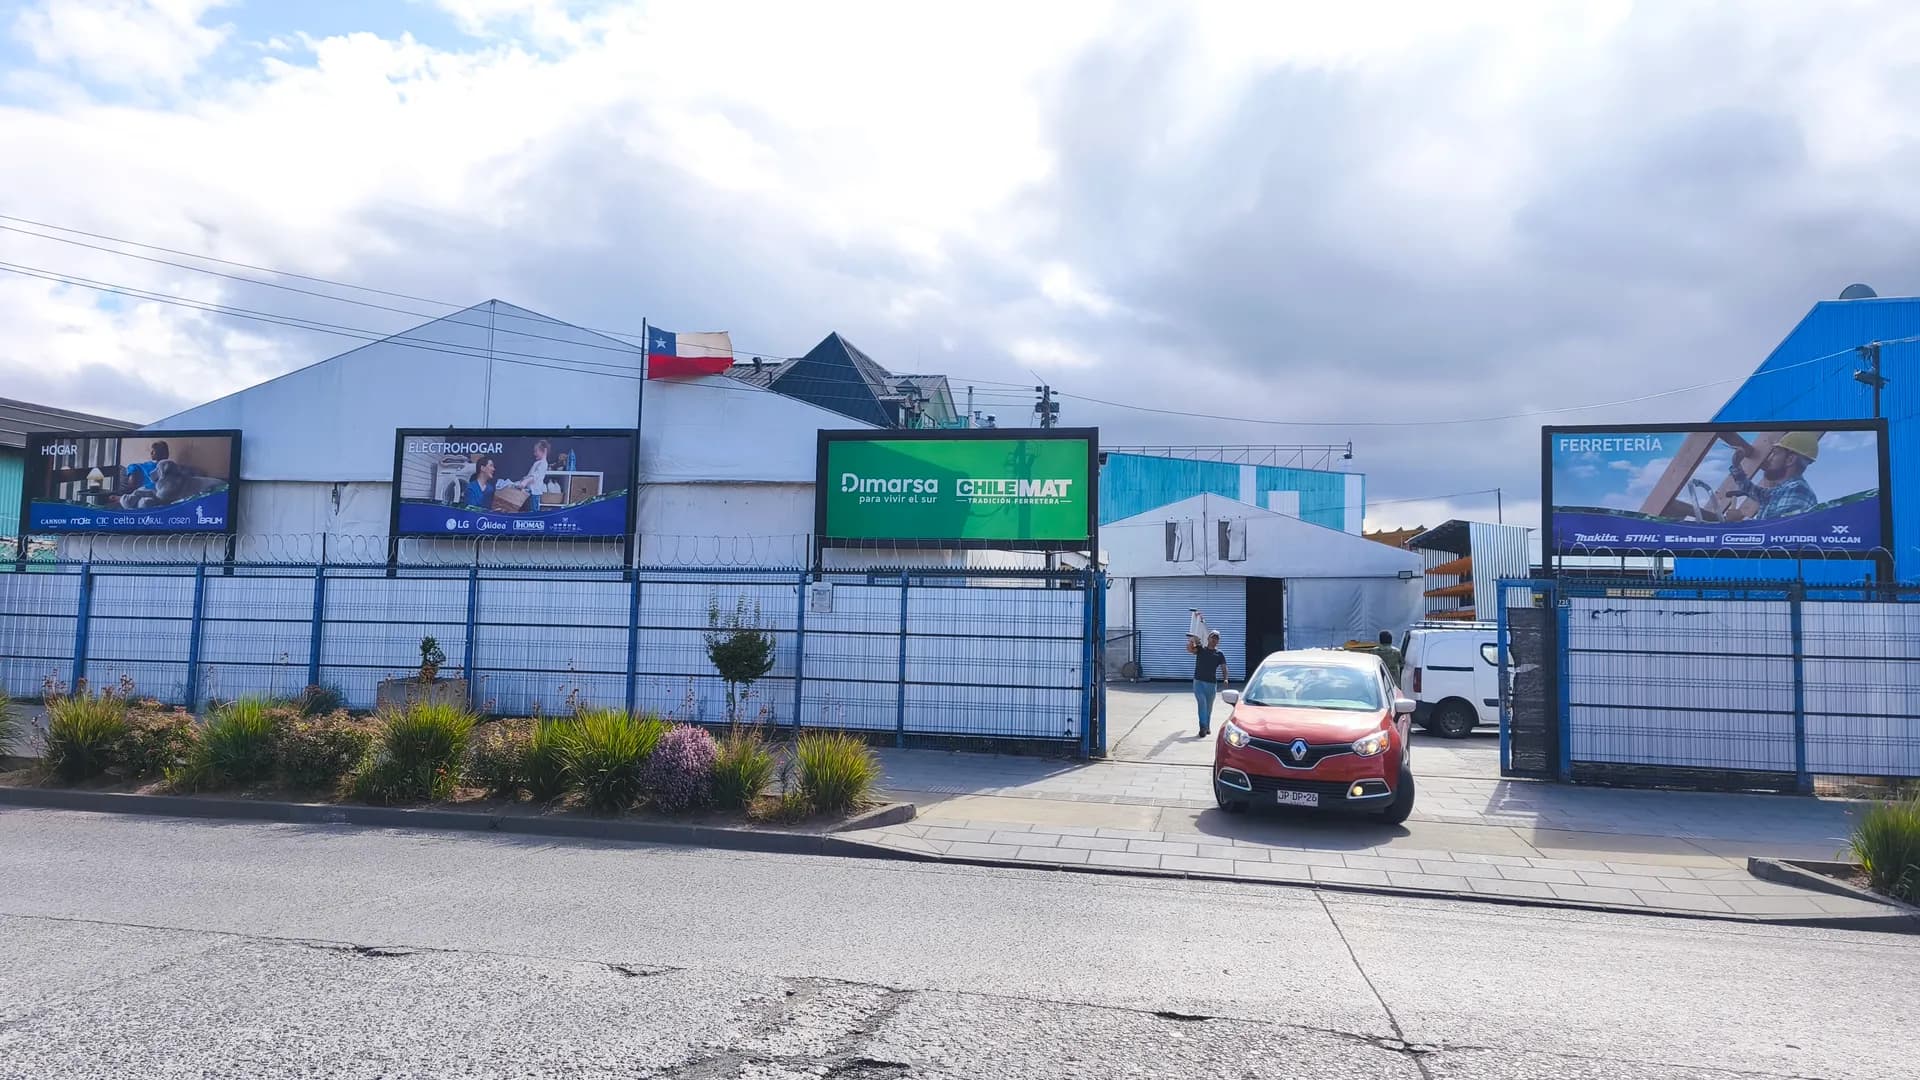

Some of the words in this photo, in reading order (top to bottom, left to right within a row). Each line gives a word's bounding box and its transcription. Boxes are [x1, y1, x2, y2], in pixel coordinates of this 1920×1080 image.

[408, 442, 503, 454] ELECTROHOGAR
[1560, 434, 1662, 452] FERRETERÍA
[41, 444, 78, 456] HOGAR
[841, 473, 938, 493] Dimarsa
[957, 478, 1072, 497] CHILEMAT
[859, 495, 881, 505] para
[884, 494, 906, 503] vivir
[908, 494, 918, 503] el
[921, 495, 937, 503] sur
[168, 516, 191, 525] rosen
[457, 520, 470, 529] LG
[477, 518, 507, 530] Midea
[514, 520, 544, 530] THOMAS
[1770, 535, 1818, 543] HYUNDAI
[1820, 536, 1861, 544] VOLCAN
